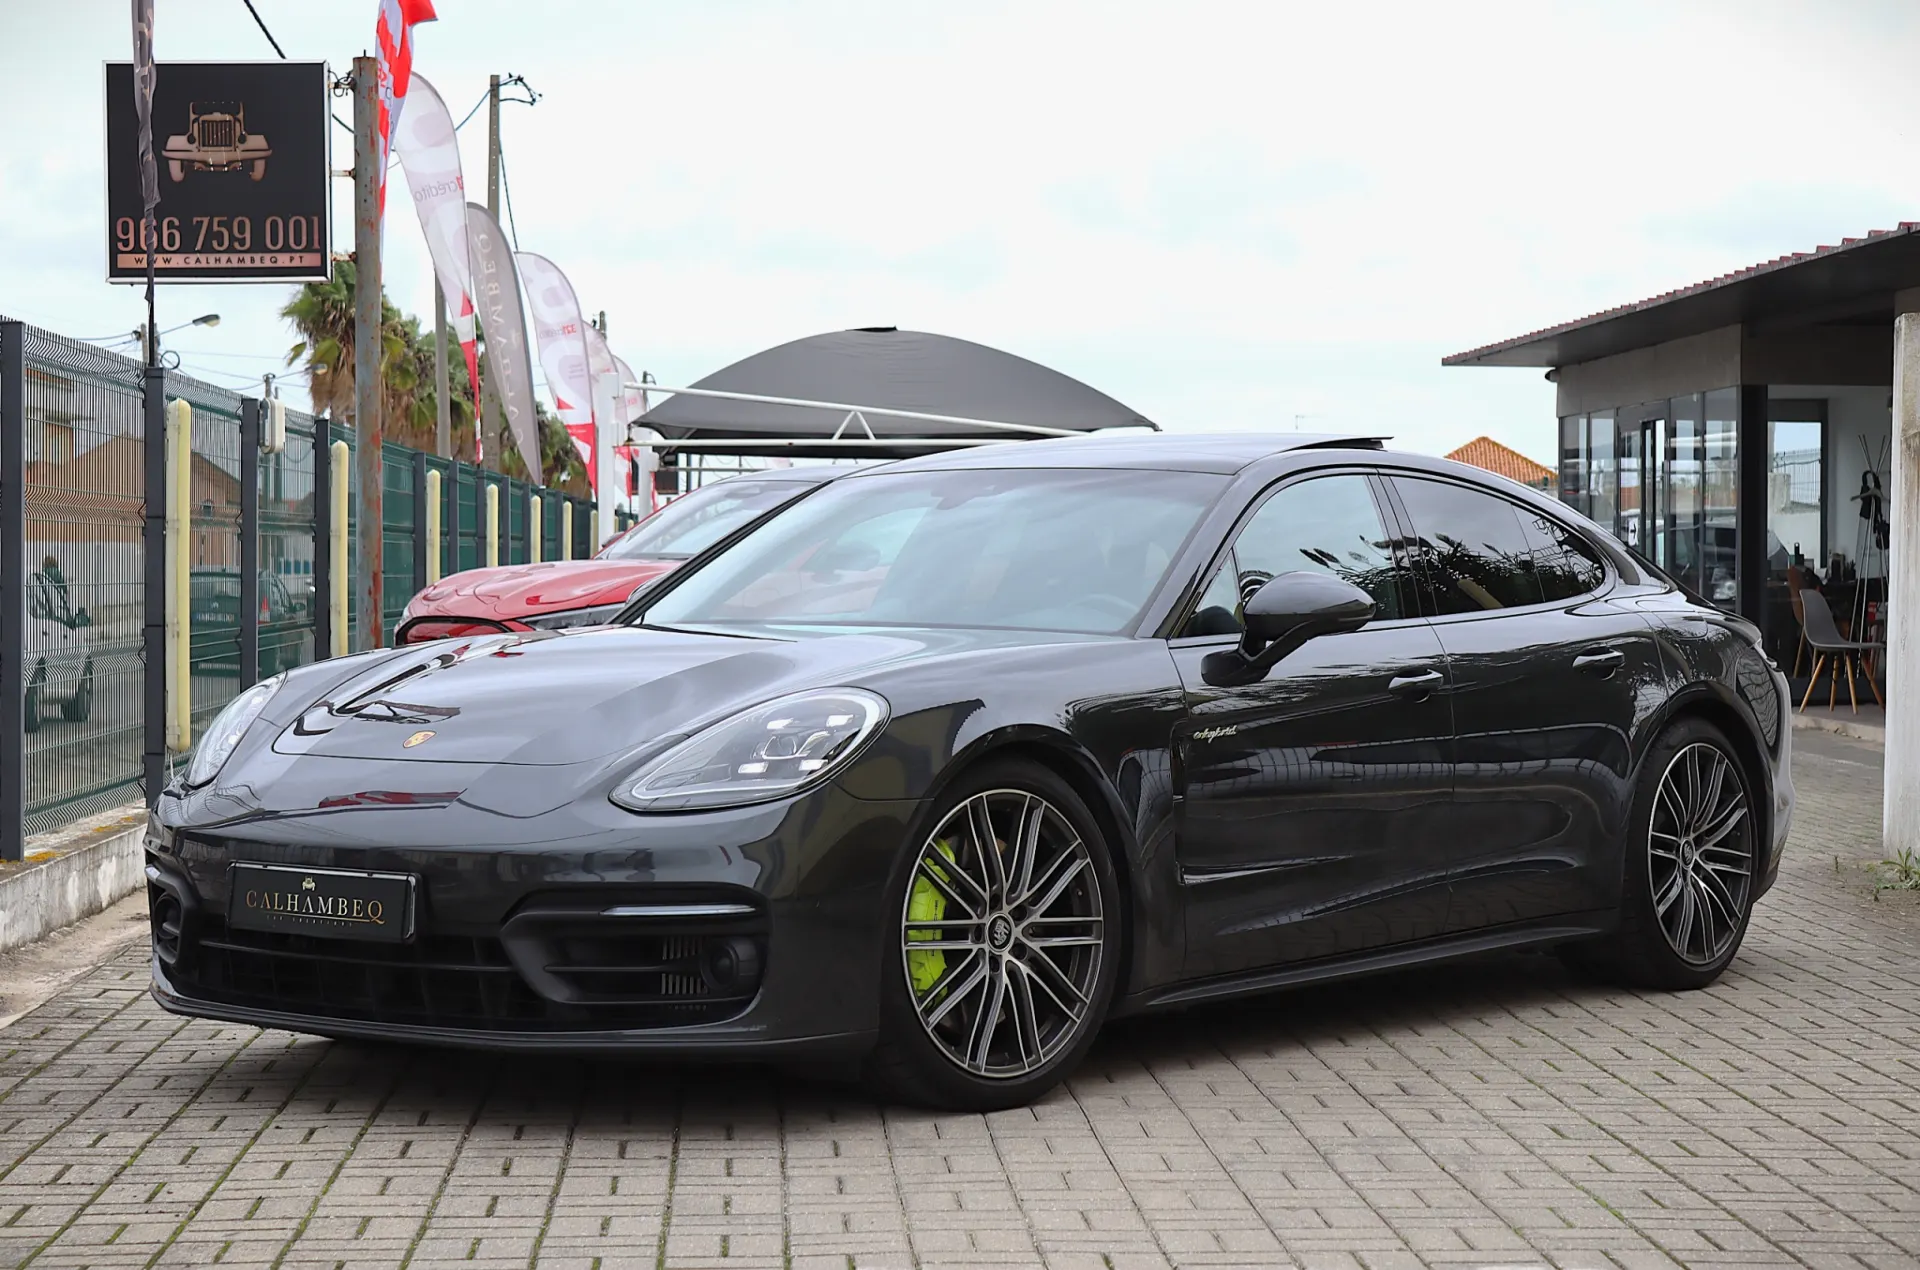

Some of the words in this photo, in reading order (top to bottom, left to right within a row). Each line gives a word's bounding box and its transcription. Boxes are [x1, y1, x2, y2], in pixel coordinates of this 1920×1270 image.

[116, 216, 181, 252] 966
[192, 216, 251, 251] 759
[265, 215, 320, 251] 001
[245, 890, 385, 925] CALHAMBEQ
